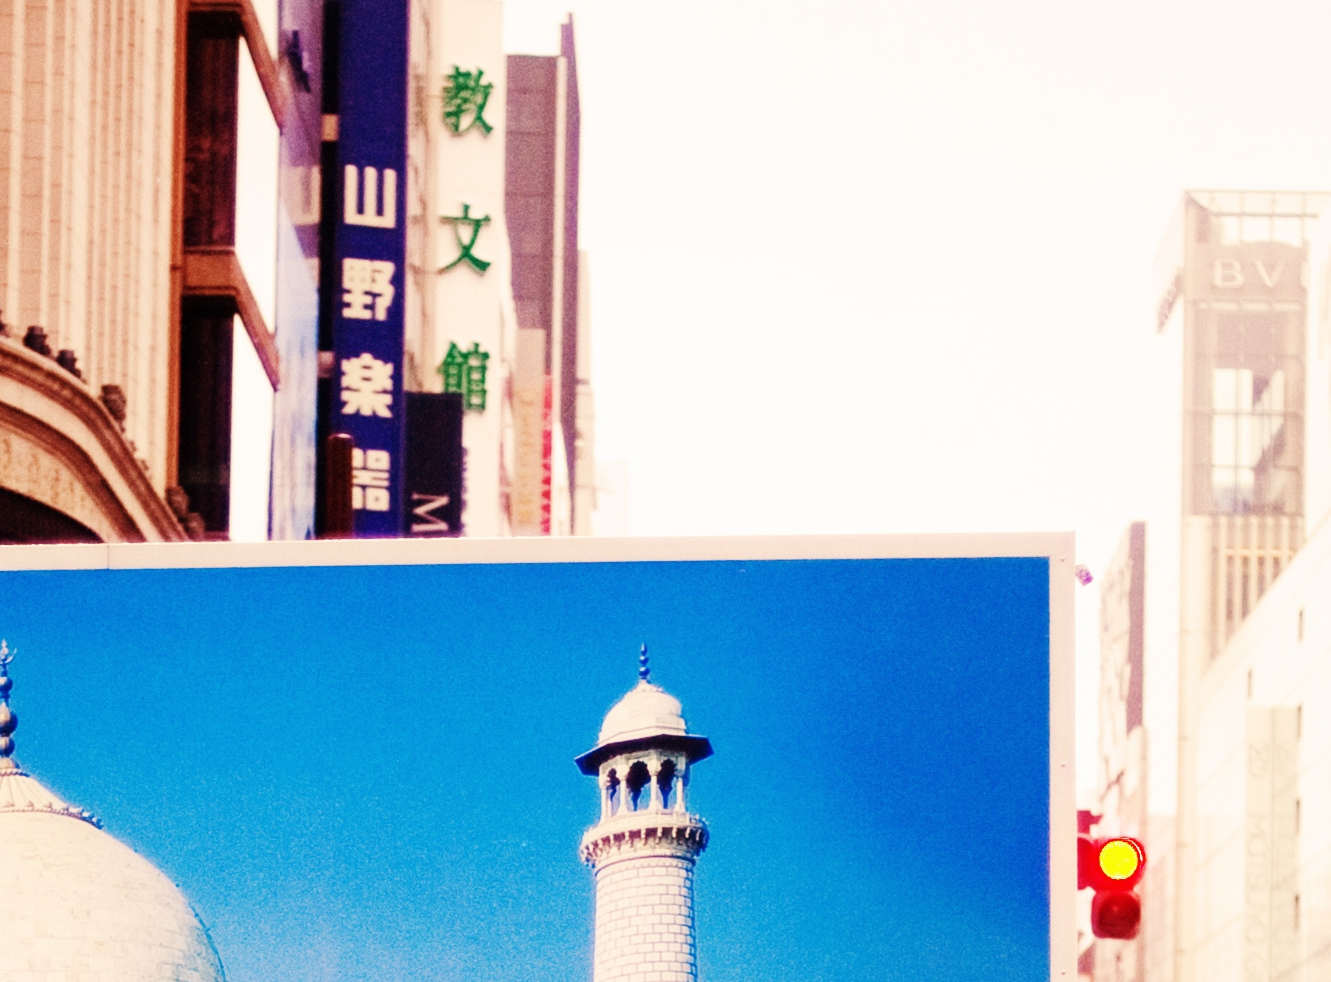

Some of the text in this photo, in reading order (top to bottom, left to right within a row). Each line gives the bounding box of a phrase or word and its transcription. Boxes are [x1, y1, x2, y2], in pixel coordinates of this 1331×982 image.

[340, 163, 398, 512] 山野楽器
[438, 64, 494, 415] 教文館
